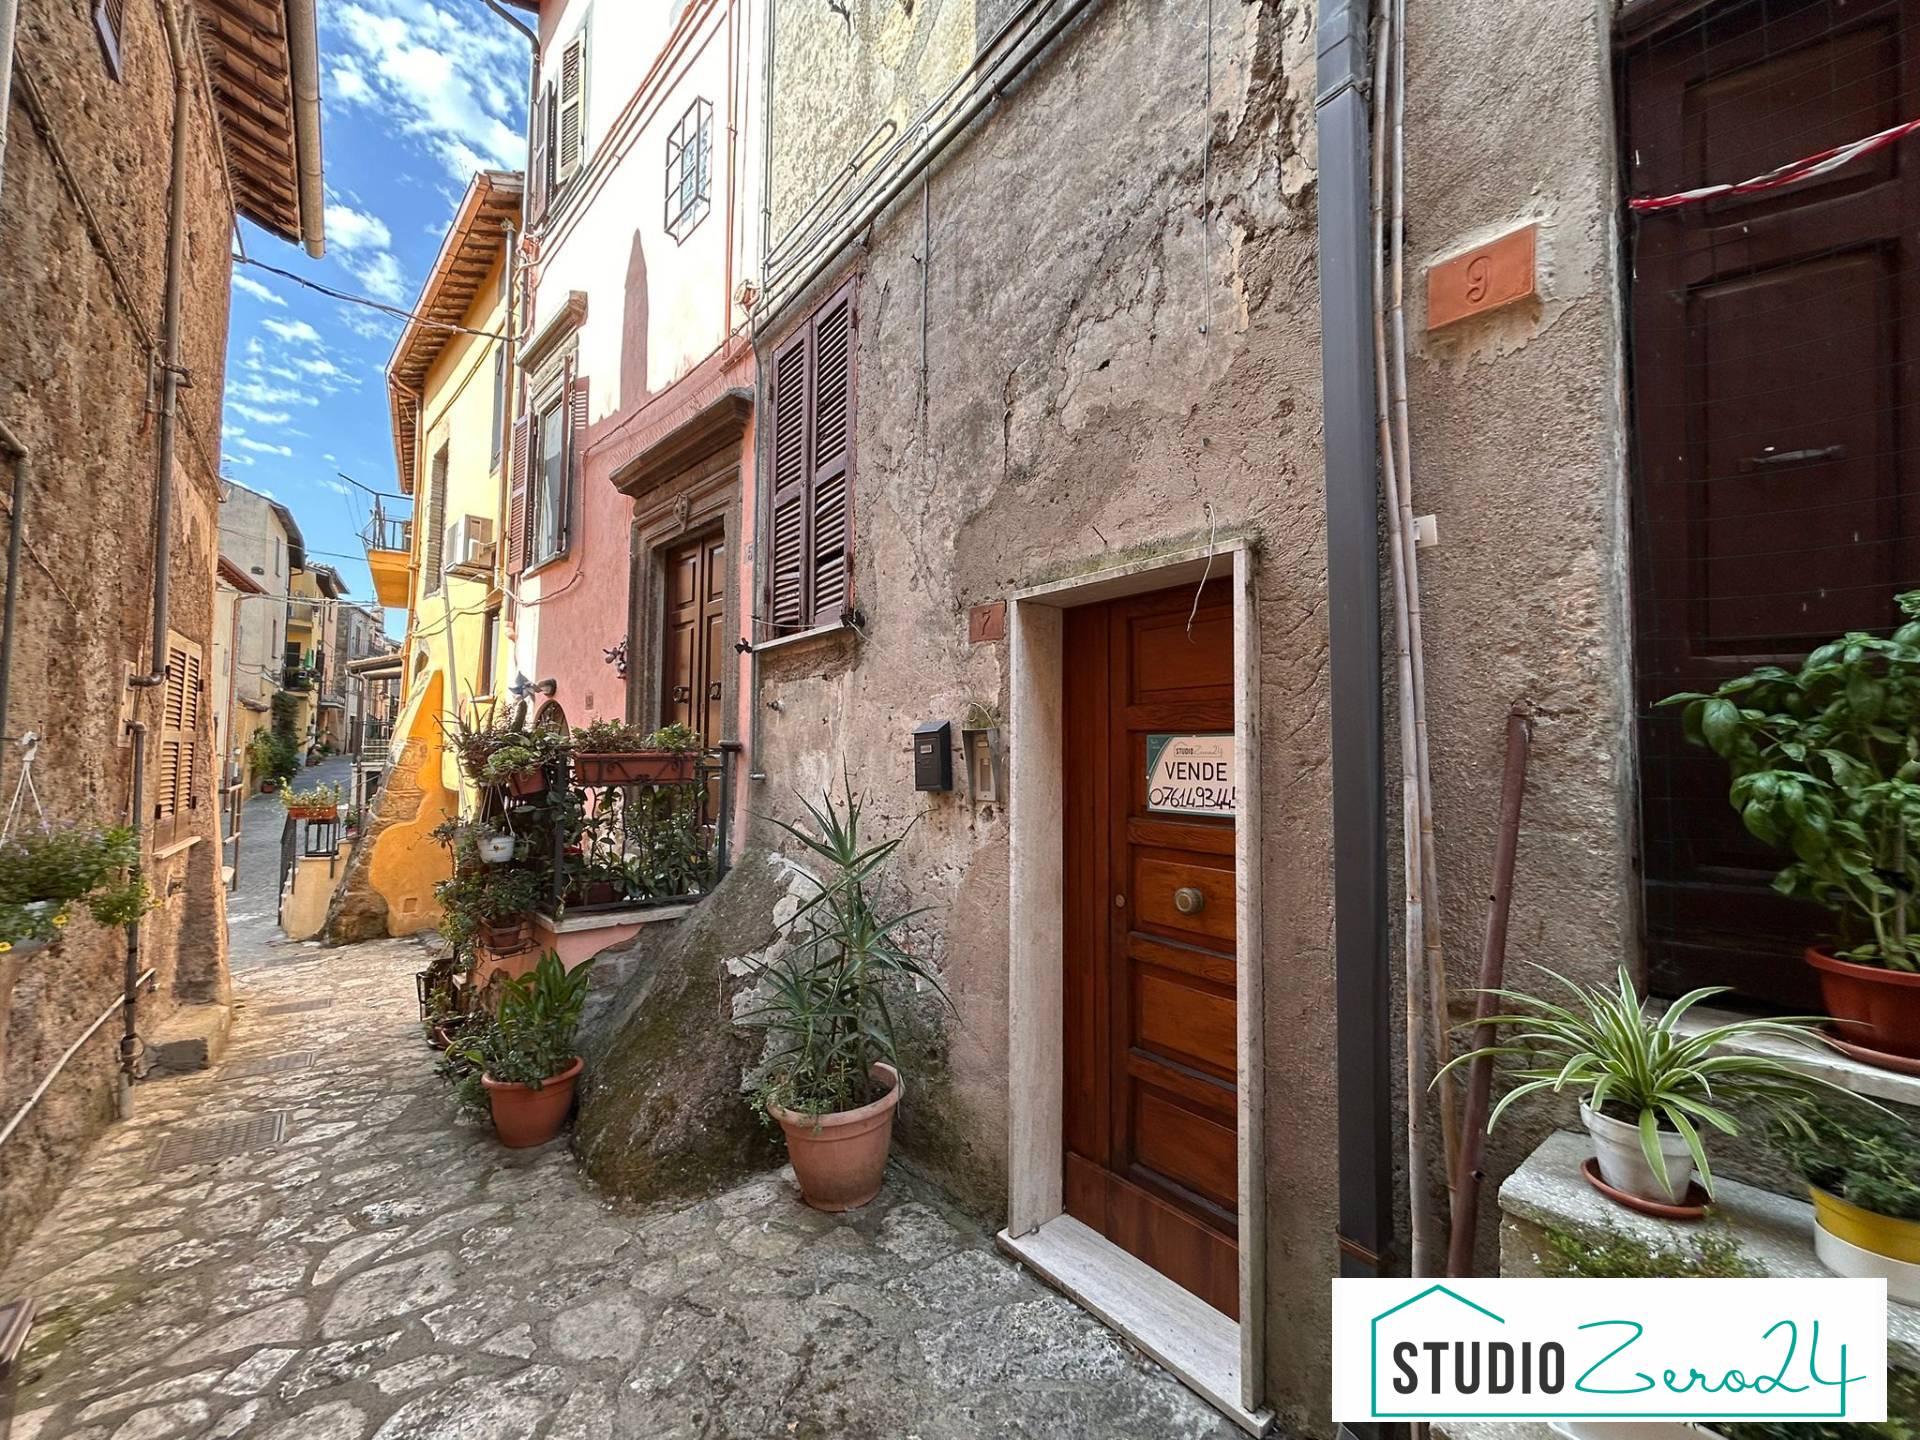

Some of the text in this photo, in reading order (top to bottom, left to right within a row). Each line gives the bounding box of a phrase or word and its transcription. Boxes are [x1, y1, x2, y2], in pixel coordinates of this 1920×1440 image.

[1465, 256, 1492, 304] 9
[981, 610, 991, 636] 7
[1165, 762, 1227, 781] VENDE
